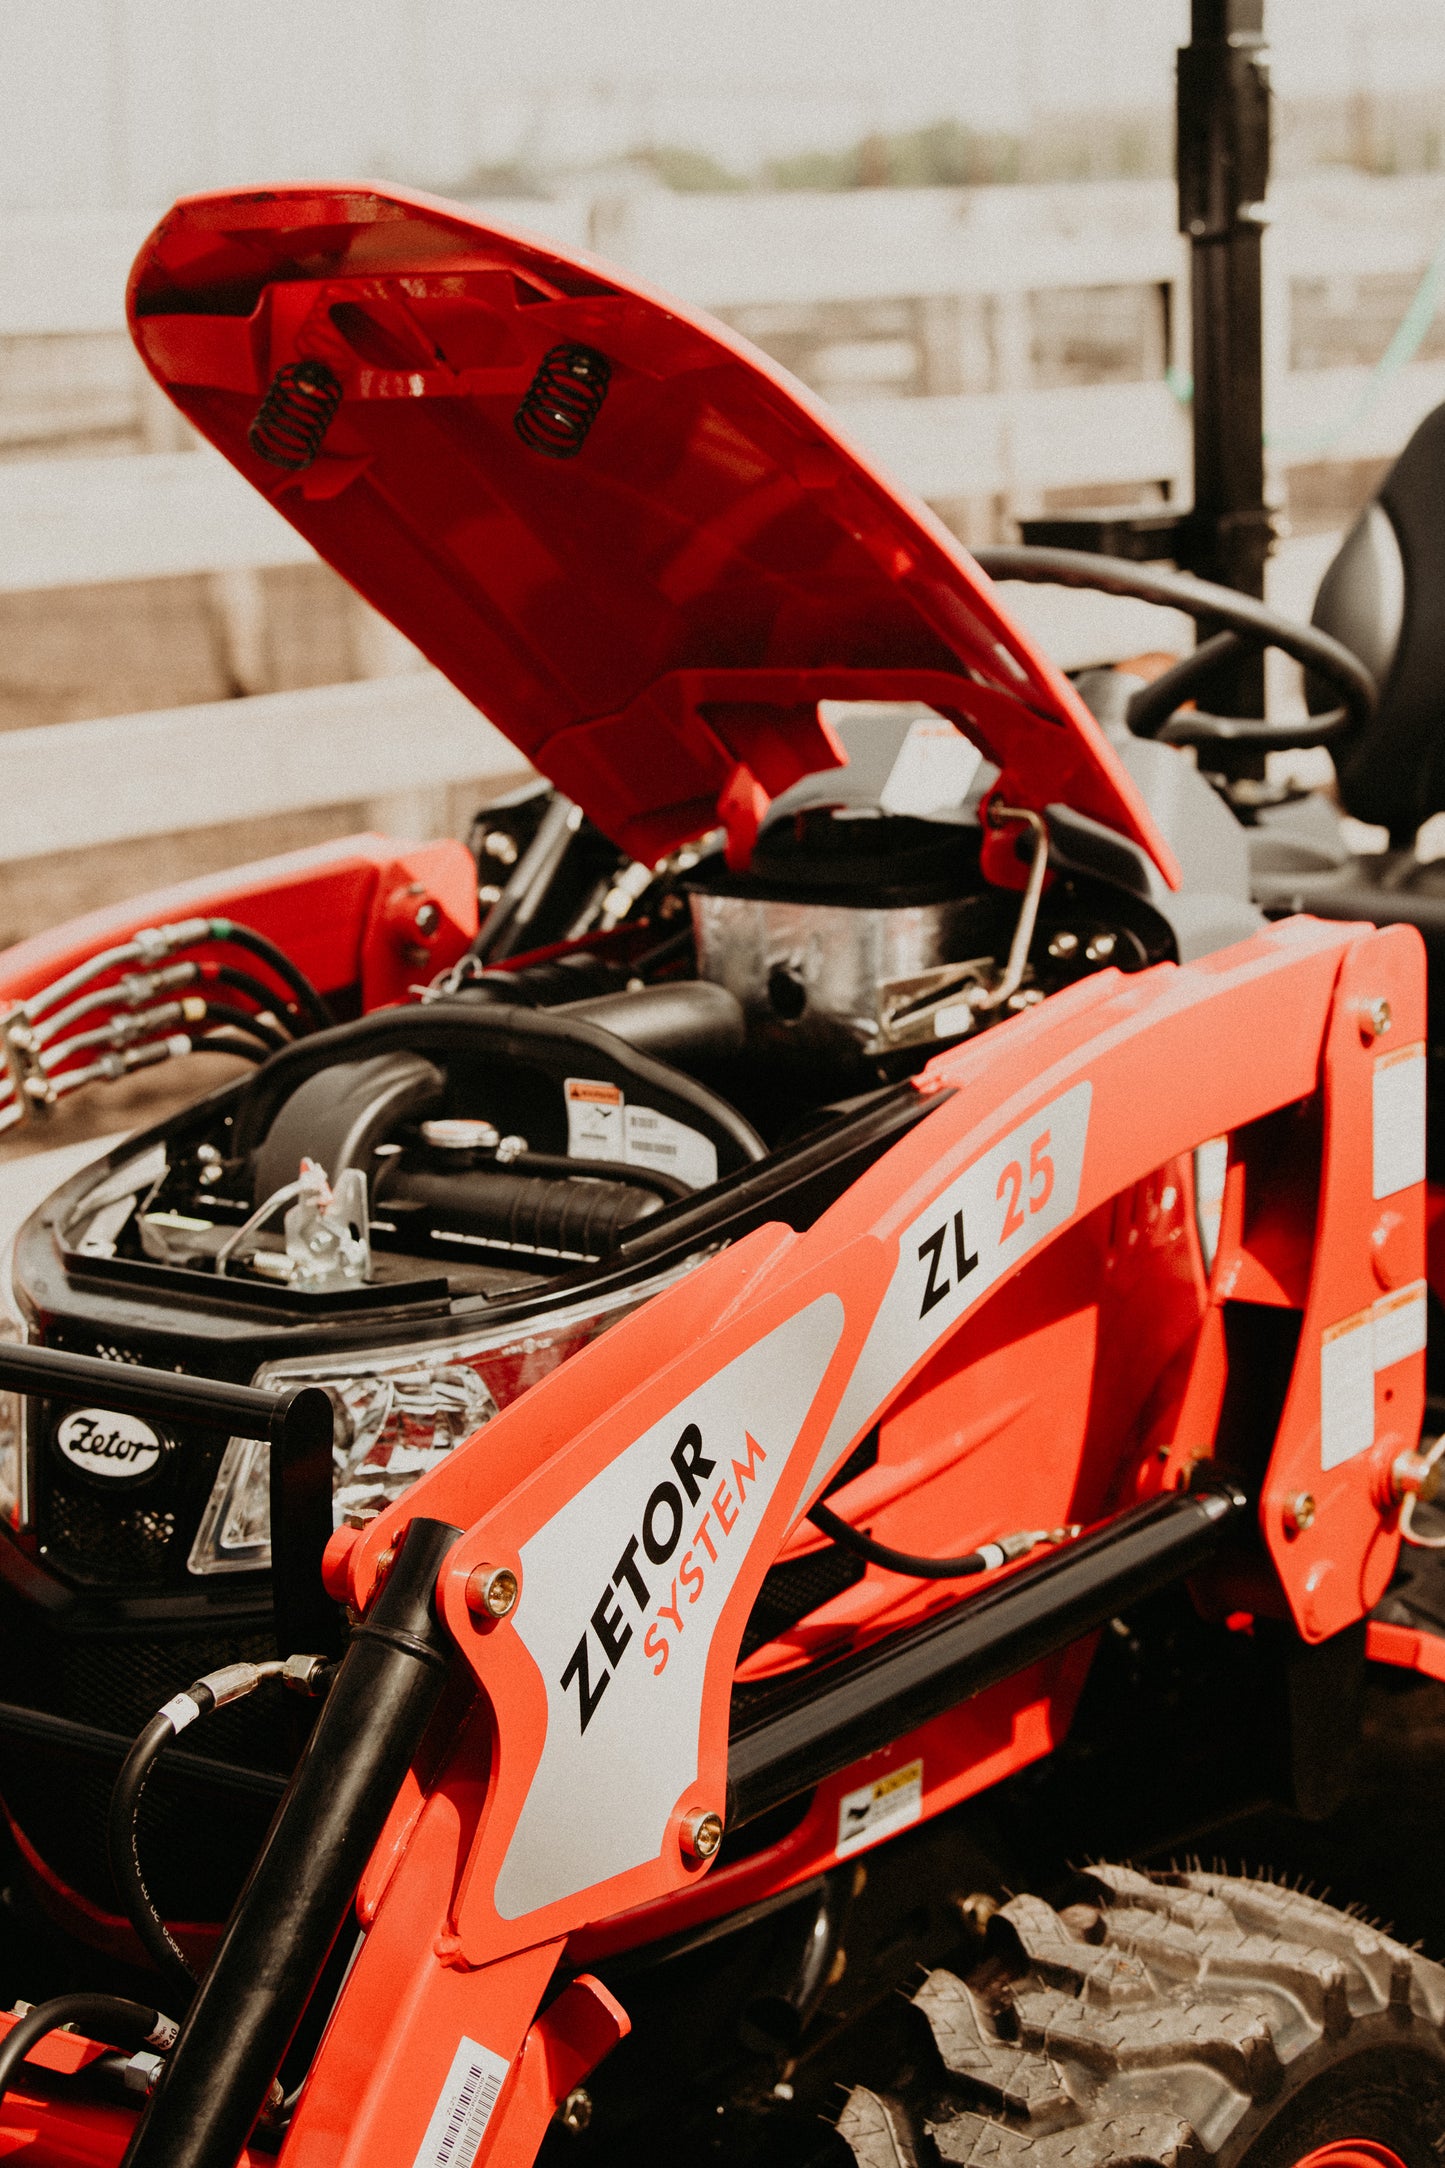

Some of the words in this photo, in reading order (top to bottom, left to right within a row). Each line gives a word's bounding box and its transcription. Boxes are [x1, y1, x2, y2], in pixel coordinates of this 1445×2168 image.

[918, 1208, 979, 1321] ZL
[996, 1128, 1055, 1246] 25
[69, 1417, 160, 1462] Zetor
[560, 1423, 717, 1737] ZETOR
[644, 1430, 768, 1676] SYSTEM
